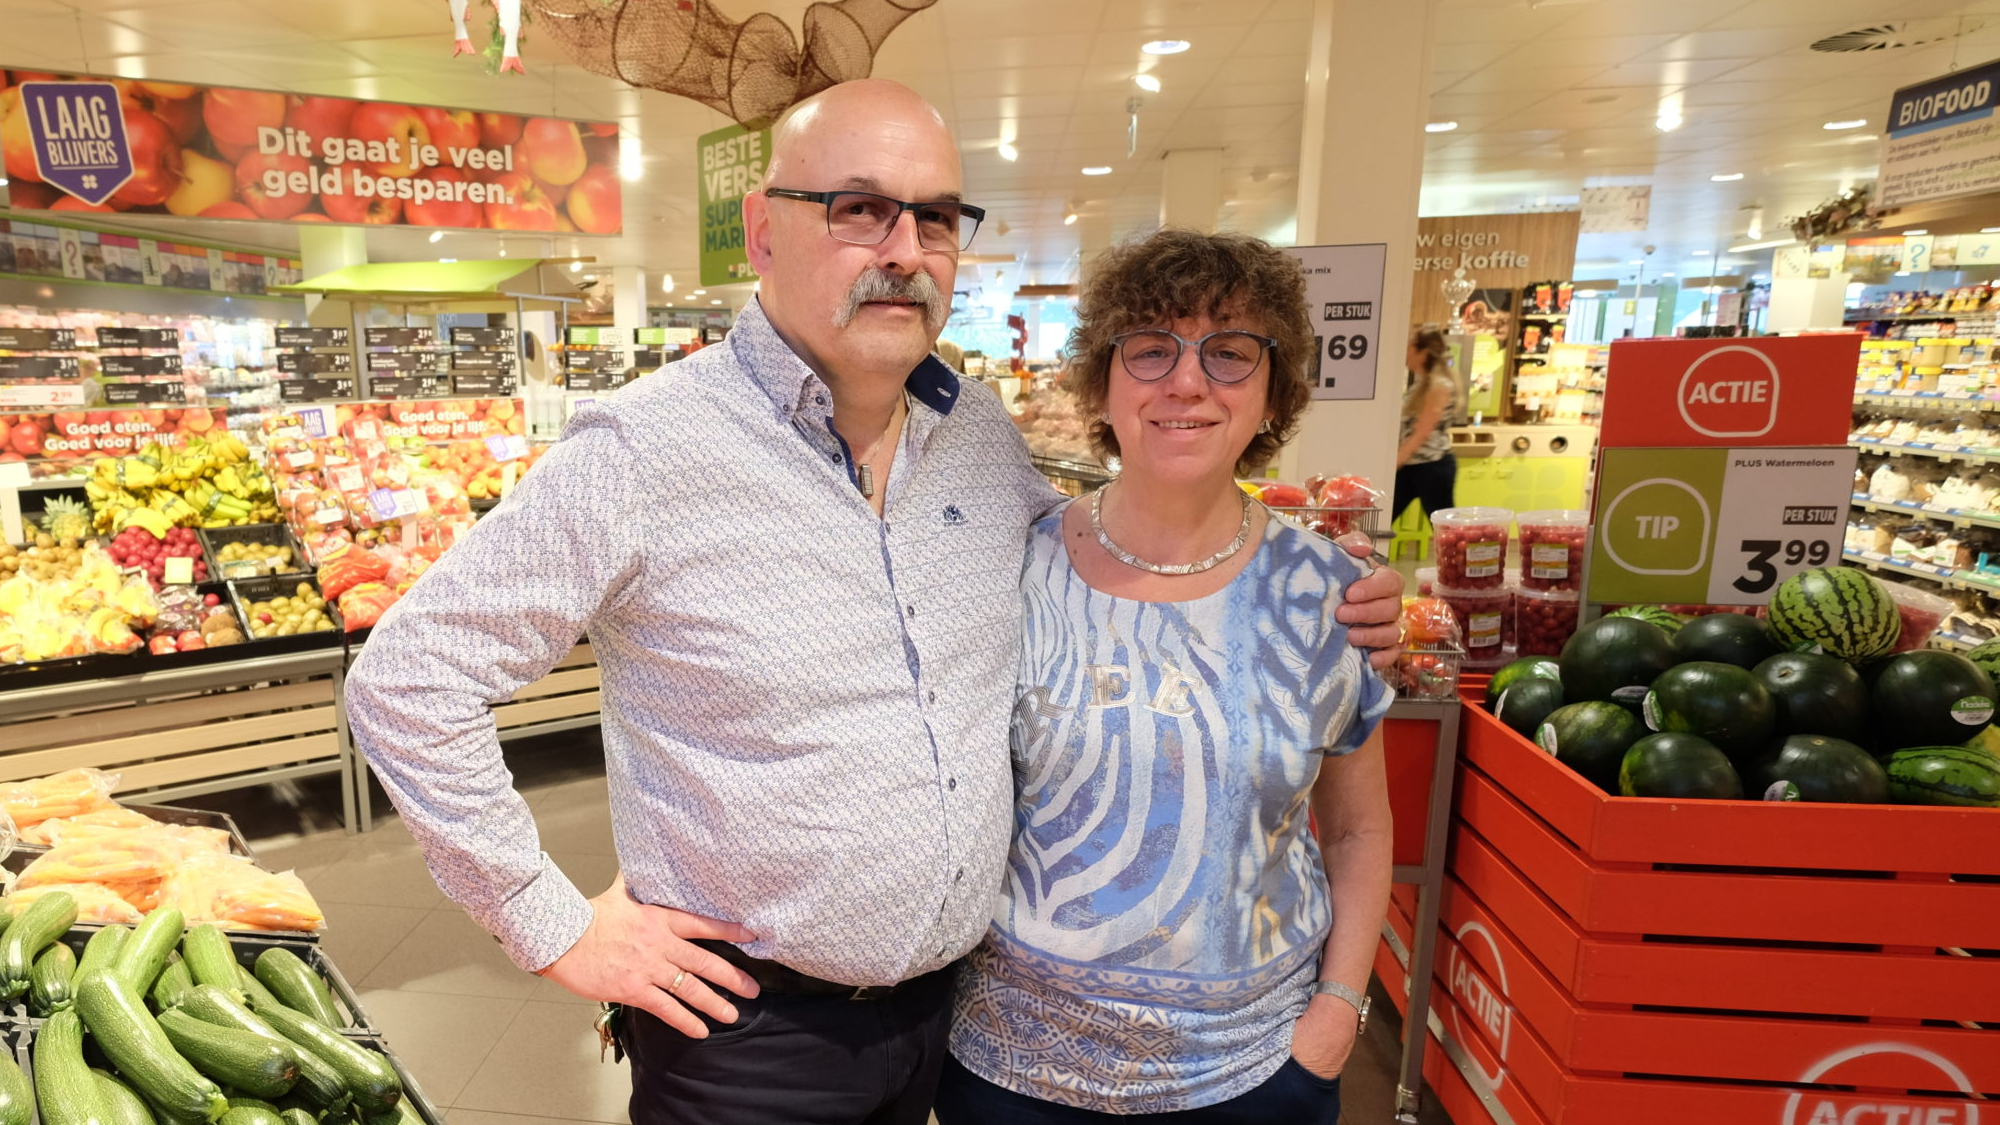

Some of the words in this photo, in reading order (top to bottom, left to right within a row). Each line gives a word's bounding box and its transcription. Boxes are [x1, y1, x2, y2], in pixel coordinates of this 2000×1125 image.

[1899, 80, 1991, 126] BIOFOOD
[36, 96, 111, 140] LAAG
[46, 140, 119, 165] BLIJVERS
[257, 126, 313, 158] Dit
[322, 136, 401, 165] gaat
[409, 137, 440, 170] je
[448, 144, 513, 171] veel
[703, 132, 762, 171] BESTE
[263, 166, 343, 198] geld
[353, 168, 514, 205] besparen.
[704, 160, 763, 202] VERS
[1417, 233, 1436, 247] w
[1442, 230, 1500, 250] eigen
[738, 263, 756, 279] PL
[1315, 266, 1331, 274] mix
[1413, 256, 1452, 271] erse
[1461, 251, 1530, 270] koffie
[1325, 306, 1343, 318] PER
[1345, 305, 1371, 317] STUK
[1688, 380, 1768, 405] ACTIE
[400, 410, 434, 423] Goed
[437, 410, 469, 422] eten.
[66, 421, 111, 435] Goed
[115, 420, 156, 434] eten.
[383, 425, 418, 437] Goed
[421, 424, 450, 435] voor
[452, 423, 464, 435] je
[44, 437, 90, 451] Goed
[94, 436, 133, 449] voor
[1735, 459, 1762, 468] PLUS
[1765, 459, 1835, 468] Watermeloen
[1784, 509, 1805, 523] PER
[1807, 508, 1837, 523] STUK
[1635, 516, 1680, 540] TIP
[1455, 960, 1503, 1039] ACTIE
